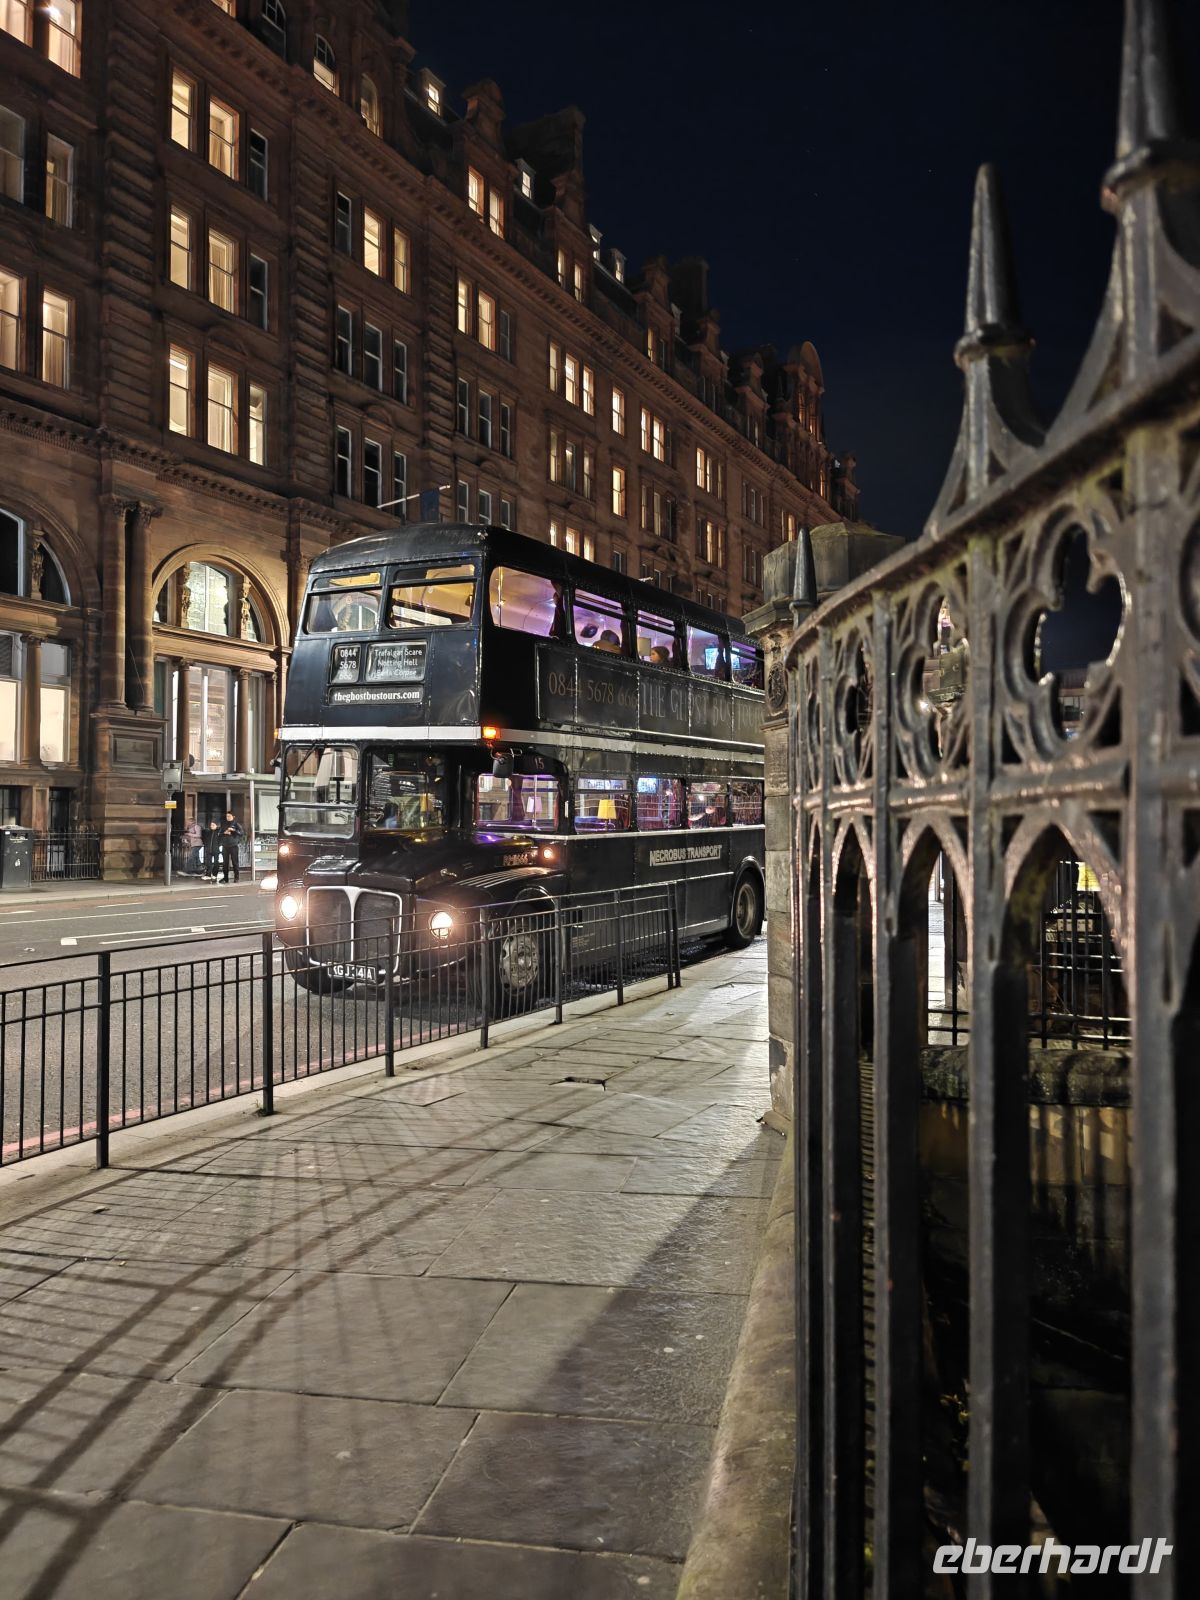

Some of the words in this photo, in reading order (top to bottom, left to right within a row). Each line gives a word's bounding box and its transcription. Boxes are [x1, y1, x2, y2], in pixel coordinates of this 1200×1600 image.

[340, 649, 357, 658] 0844
[374, 649, 403, 659] Trafalgar
[404, 648, 423, 656] Scare
[340, 660, 357, 669] 5678
[377, 659, 402, 668] Notting
[403, 658, 418, 666] Hell
[548, 671, 582, 697] 0844
[586, 679, 614, 705] 5678
[334, 691, 420, 703] theghostbustours.com
[641, 682, 666, 718] THE
[670, 688, 709, 725] GHOST
[649, 848, 686, 867] NECROBUS
[687, 844, 722, 860] TRANSPORT
